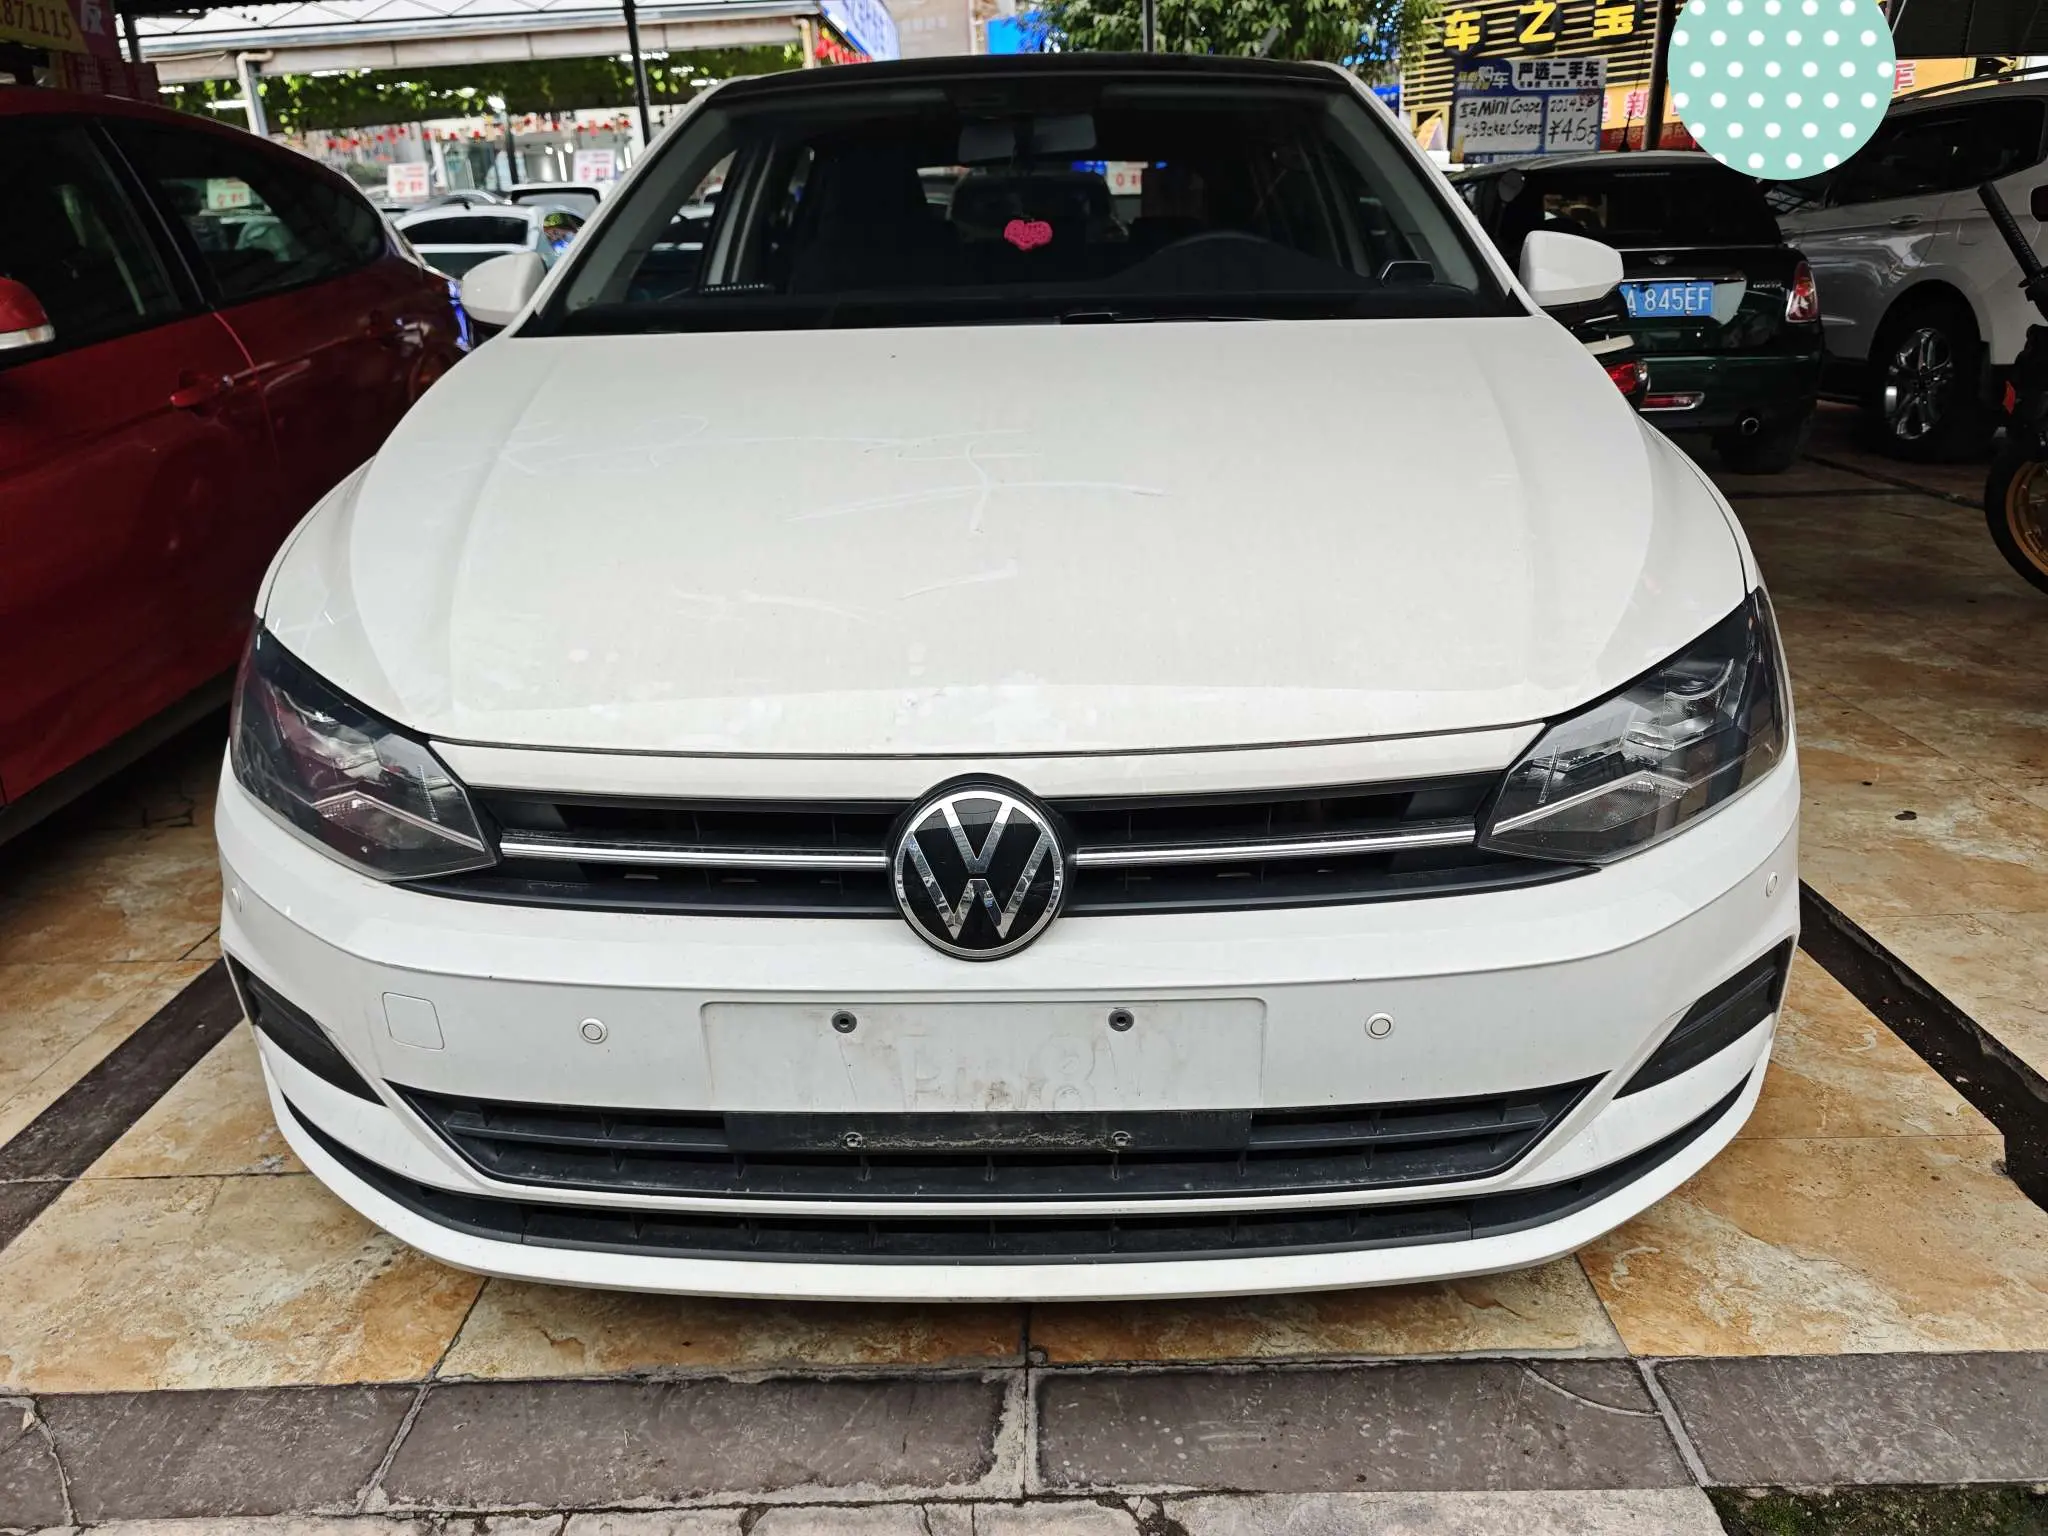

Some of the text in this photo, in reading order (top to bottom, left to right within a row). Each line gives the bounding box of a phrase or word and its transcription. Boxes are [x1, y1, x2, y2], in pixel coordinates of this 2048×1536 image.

[0, 0, 72, 41] 871115
[1517, 60, 1600, 80] 严选二手车
